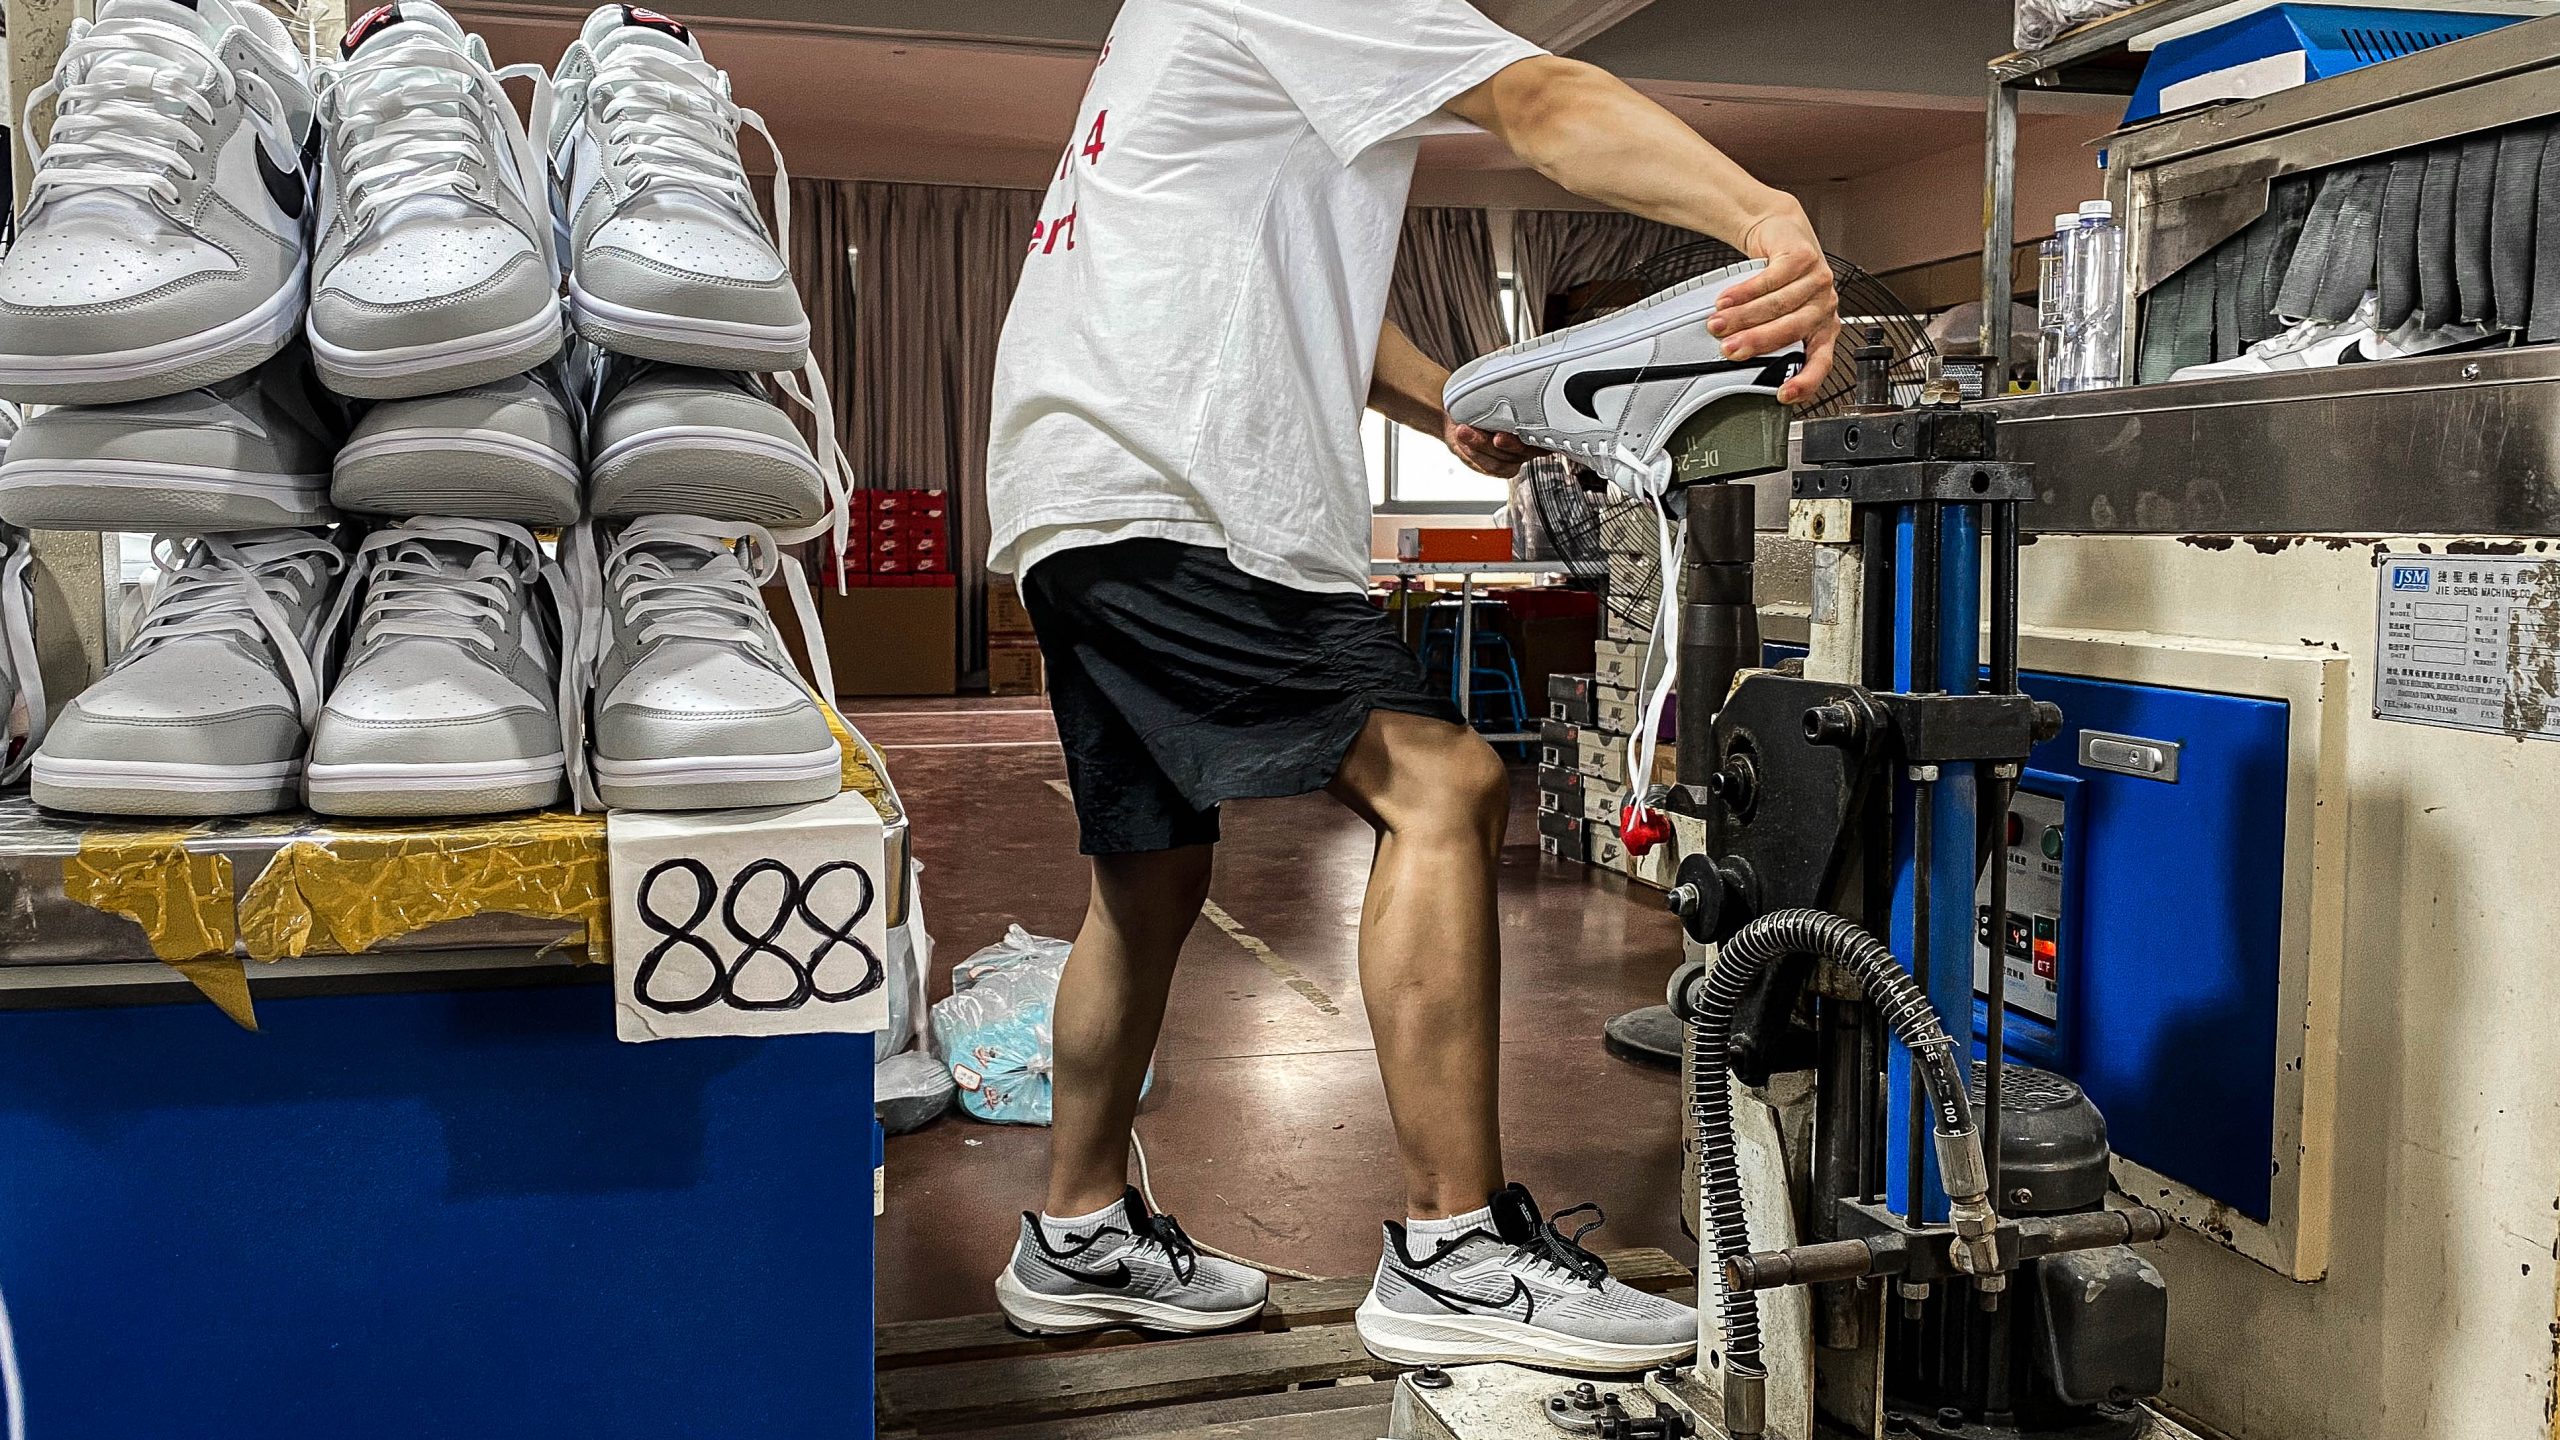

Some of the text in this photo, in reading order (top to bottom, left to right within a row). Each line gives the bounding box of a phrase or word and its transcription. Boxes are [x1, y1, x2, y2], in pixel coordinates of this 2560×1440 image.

[1081, 109, 1108, 165] 4
[2396, 570, 2427, 587] JSM
[2435, 586, 2450, 595] JIE
[2453, 587, 2478, 597] SHENG
[634, 857, 885, 1014] 888
[1942, 1100, 1958, 1123] 100
